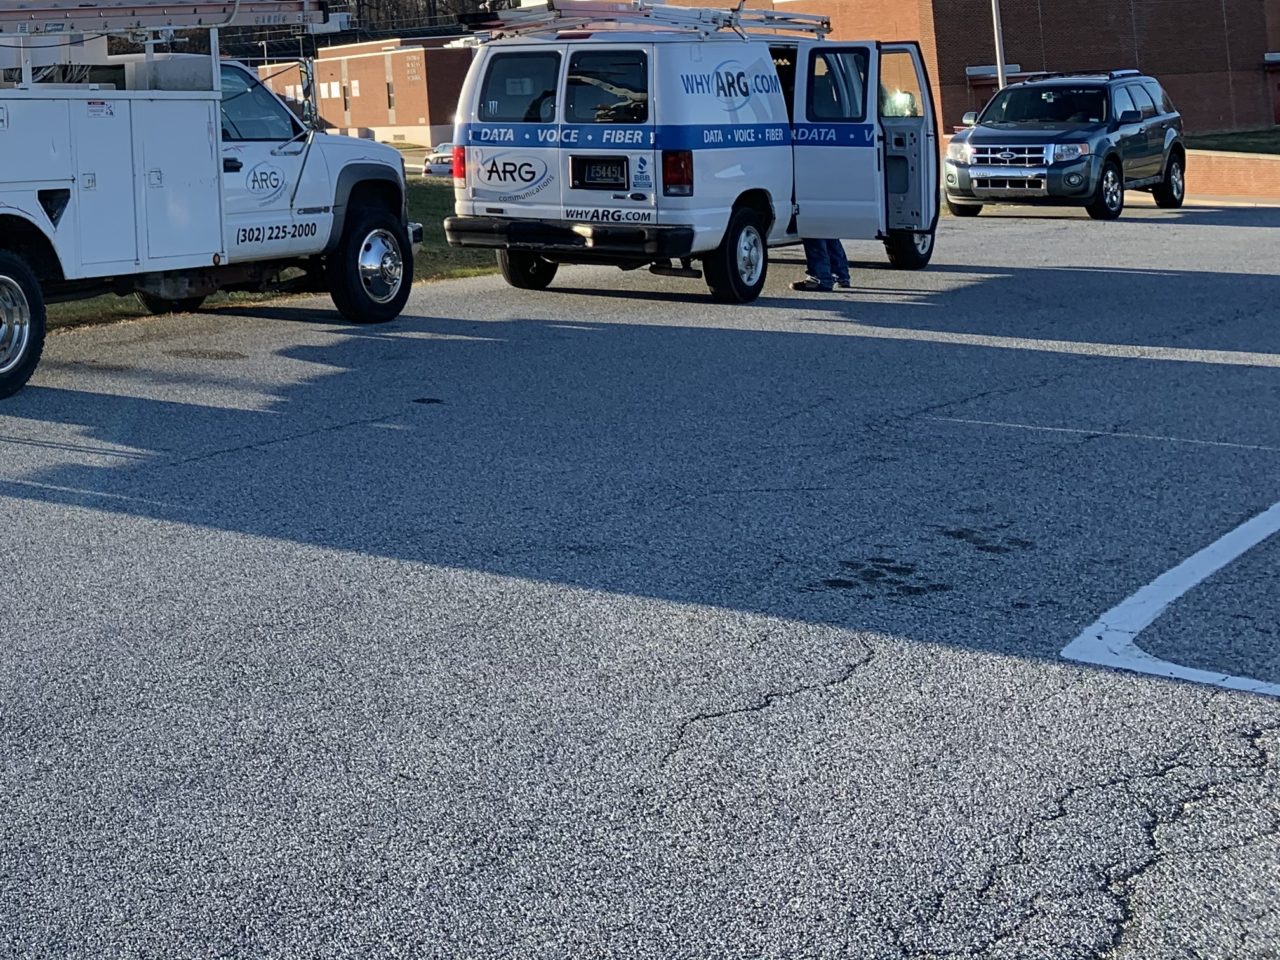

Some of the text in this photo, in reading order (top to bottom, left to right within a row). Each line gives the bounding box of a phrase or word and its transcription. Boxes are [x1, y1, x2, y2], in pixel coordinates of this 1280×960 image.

[480, 128, 514, 141] DATA
[537, 129, 579, 142] VOICE
[602, 130, 643, 143] FIBER
[703, 130, 724, 143] DATA
[733, 129, 755, 142] VOICE
[765, 128, 784, 141] FIBER
[797, 128, 837, 141] DATA
[251, 168, 280, 190] ARG
[487, 158, 536, 182] ARG
[498, 174, 555, 202] communications
[565, 209, 651, 222] WHYARG.COM
[236, 222, 317, 246] (302) 225-2000
